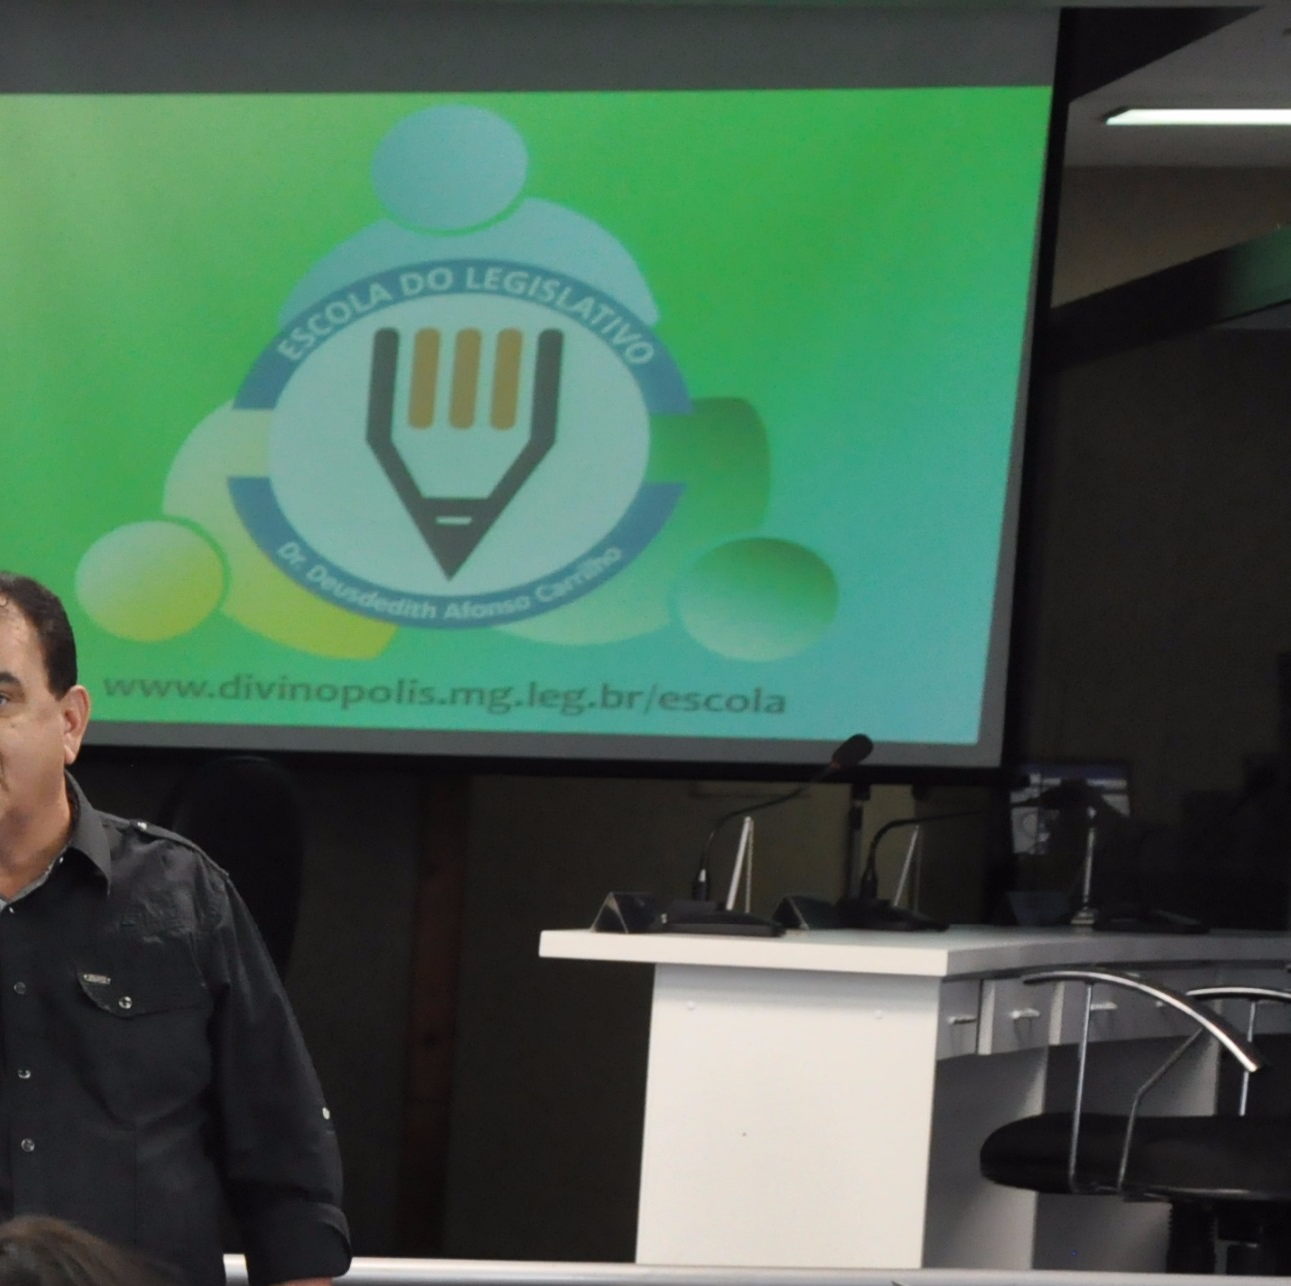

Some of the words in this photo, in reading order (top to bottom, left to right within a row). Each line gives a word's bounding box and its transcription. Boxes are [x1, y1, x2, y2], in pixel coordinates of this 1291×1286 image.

[277, 283, 393, 362] ESCOLA
[399, 267, 454, 296] DO
[465, 266, 655, 366] LEGISLATIVO
[276, 541, 308, 571] Dr.
[306, 564, 436, 619] Deusdedith
[443, 595, 531, 620] Afonso
[103, 673, 786, 717] www.divinopolis.mg.leg.br/escola
